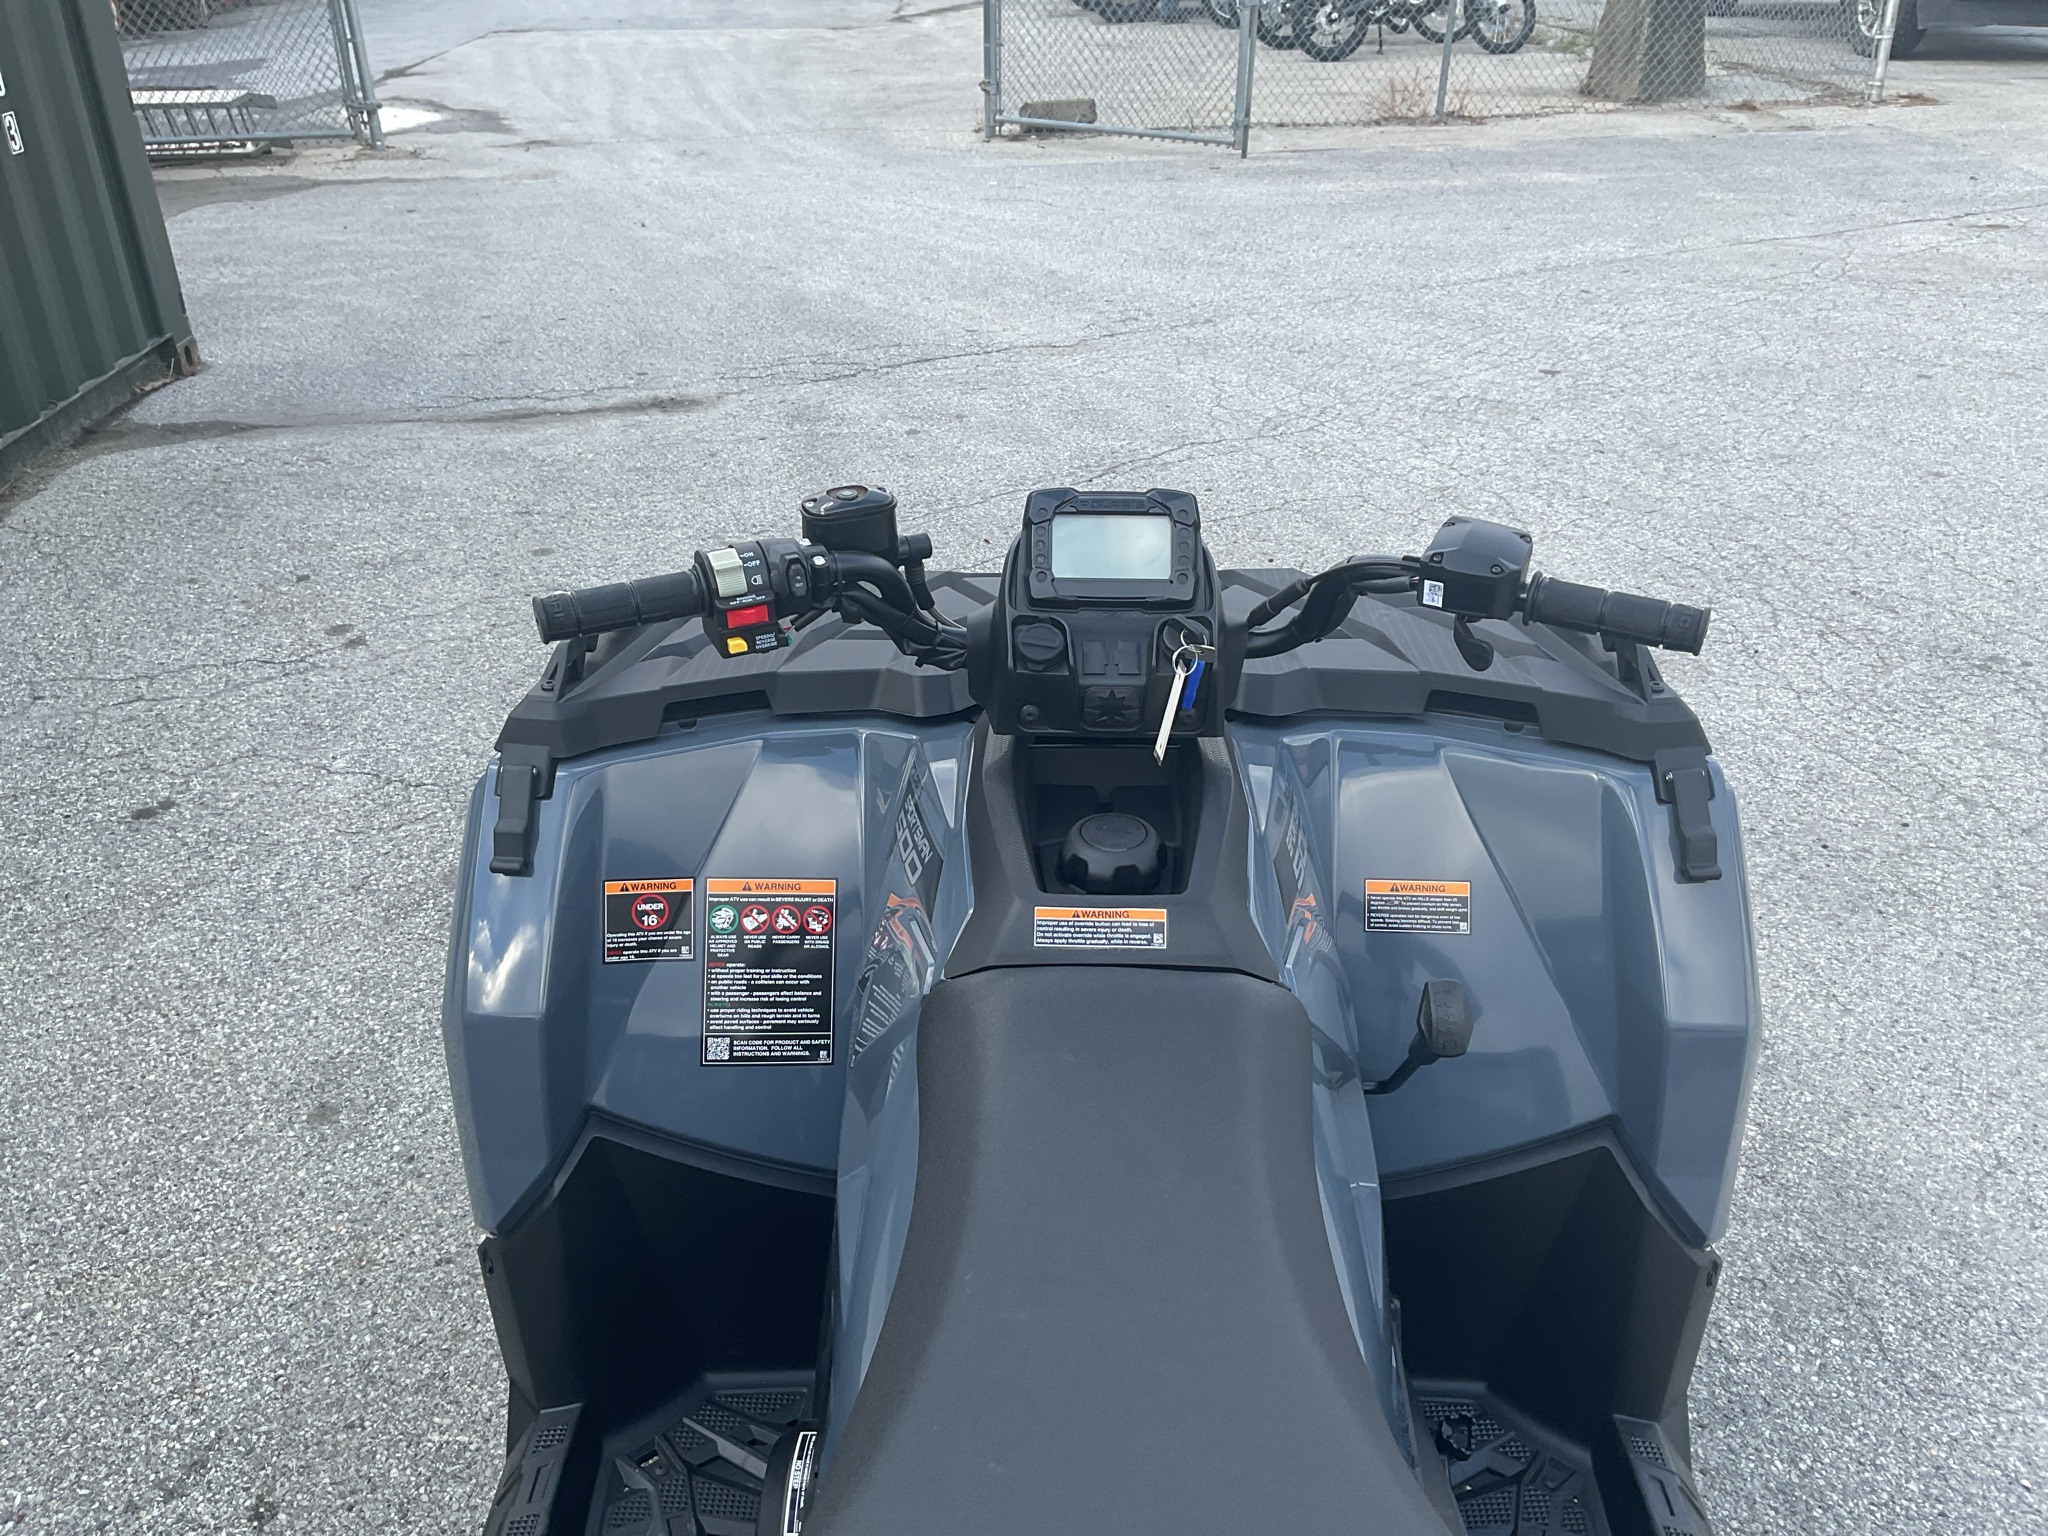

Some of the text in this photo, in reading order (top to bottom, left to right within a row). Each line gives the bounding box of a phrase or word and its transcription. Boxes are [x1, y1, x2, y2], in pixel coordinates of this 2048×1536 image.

[5, 115, 20, 151] 3
[1080, 500, 1145, 509] POLARIS
[905, 794, 933, 864] SPORTSMAN
[895, 809, 922, 886] 500
[631, 882, 676, 890] WARNING
[755, 883, 801, 891] WARNING
[1400, 884, 1445, 893] WARNING
[1081, 910, 1130, 919] WARNING
[642, 915, 657, 926] 16
[793, 1460, 802, 1489] NO STEP
